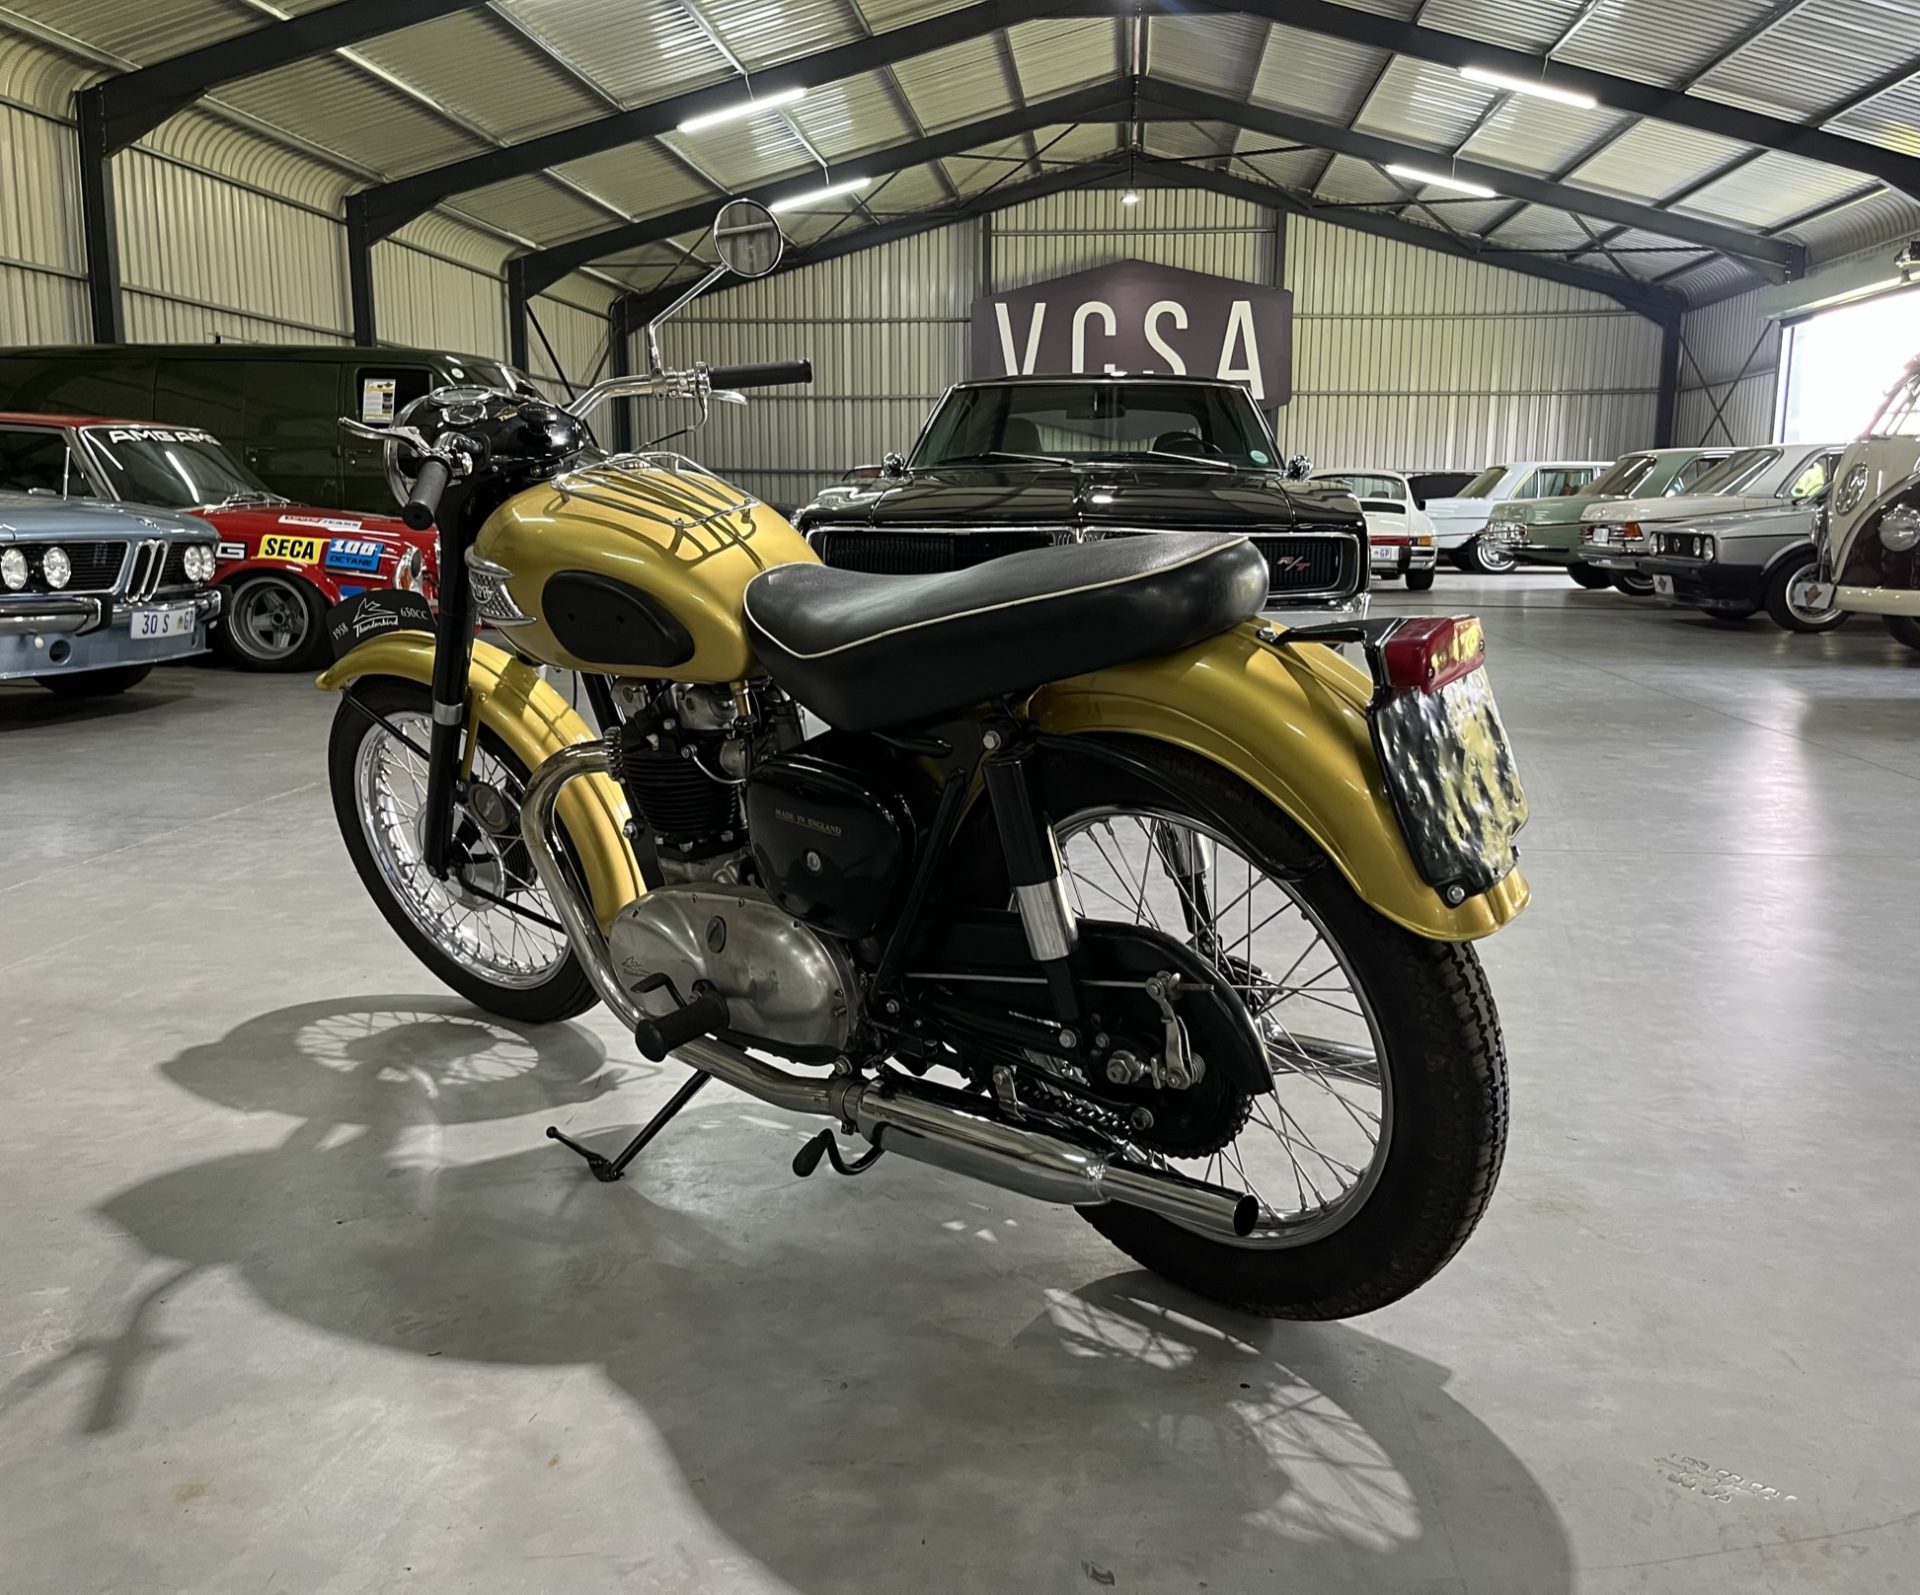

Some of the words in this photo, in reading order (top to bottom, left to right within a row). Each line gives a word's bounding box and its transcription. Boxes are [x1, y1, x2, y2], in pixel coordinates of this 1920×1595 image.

[995, 300, 1265, 400] VCSA
[109, 430, 177, 443] AMG
[265, 537, 314, 560] SECA
[331, 539, 377, 556] 100
[1379, 548, 1390, 557] GP
[329, 555, 373, 567] OCTANE
[142, 614, 158, 635] 30
[162, 613, 170, 634] S
[332, 622, 349, 640] 1958
[353, 615, 399, 638] Thunderbird
